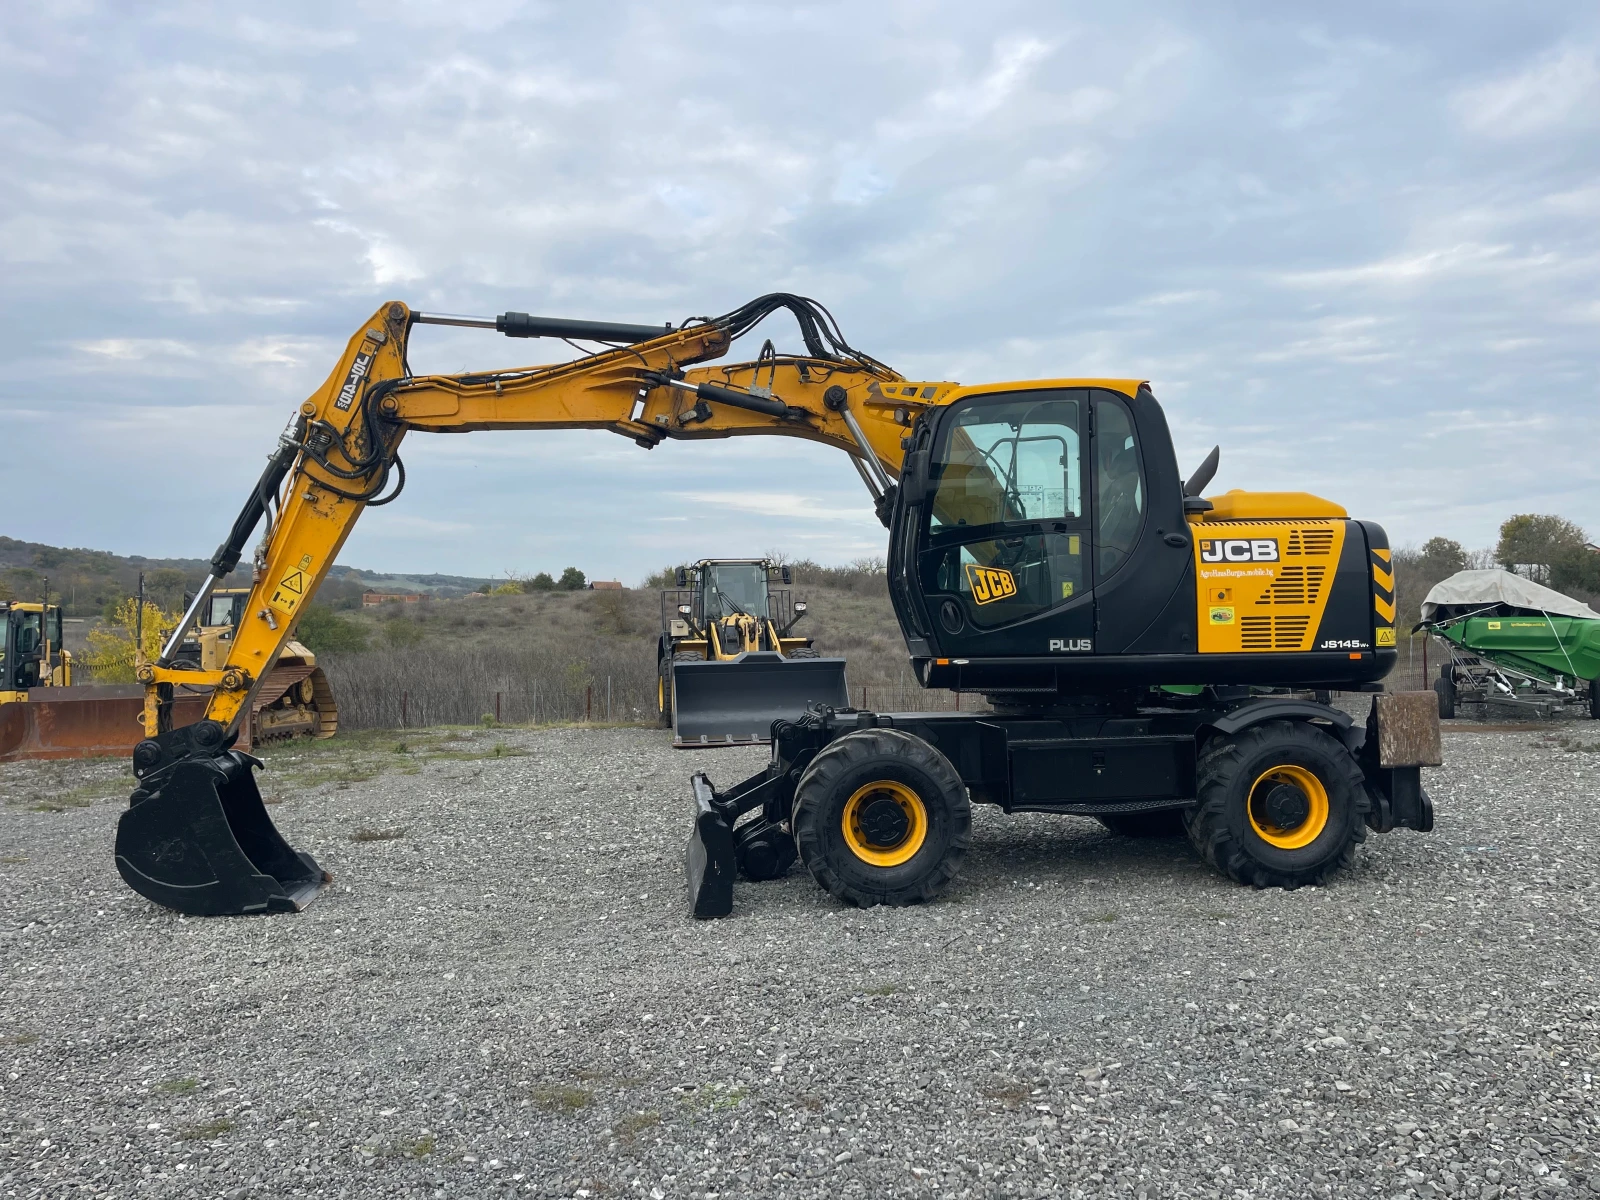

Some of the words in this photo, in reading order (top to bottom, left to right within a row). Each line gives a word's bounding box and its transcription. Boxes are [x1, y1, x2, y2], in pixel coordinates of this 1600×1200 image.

[1202, 540, 1278, 562] JCB
[974, 568, 1013, 601] JCB
[1049, 639, 1092, 652] PLUS
